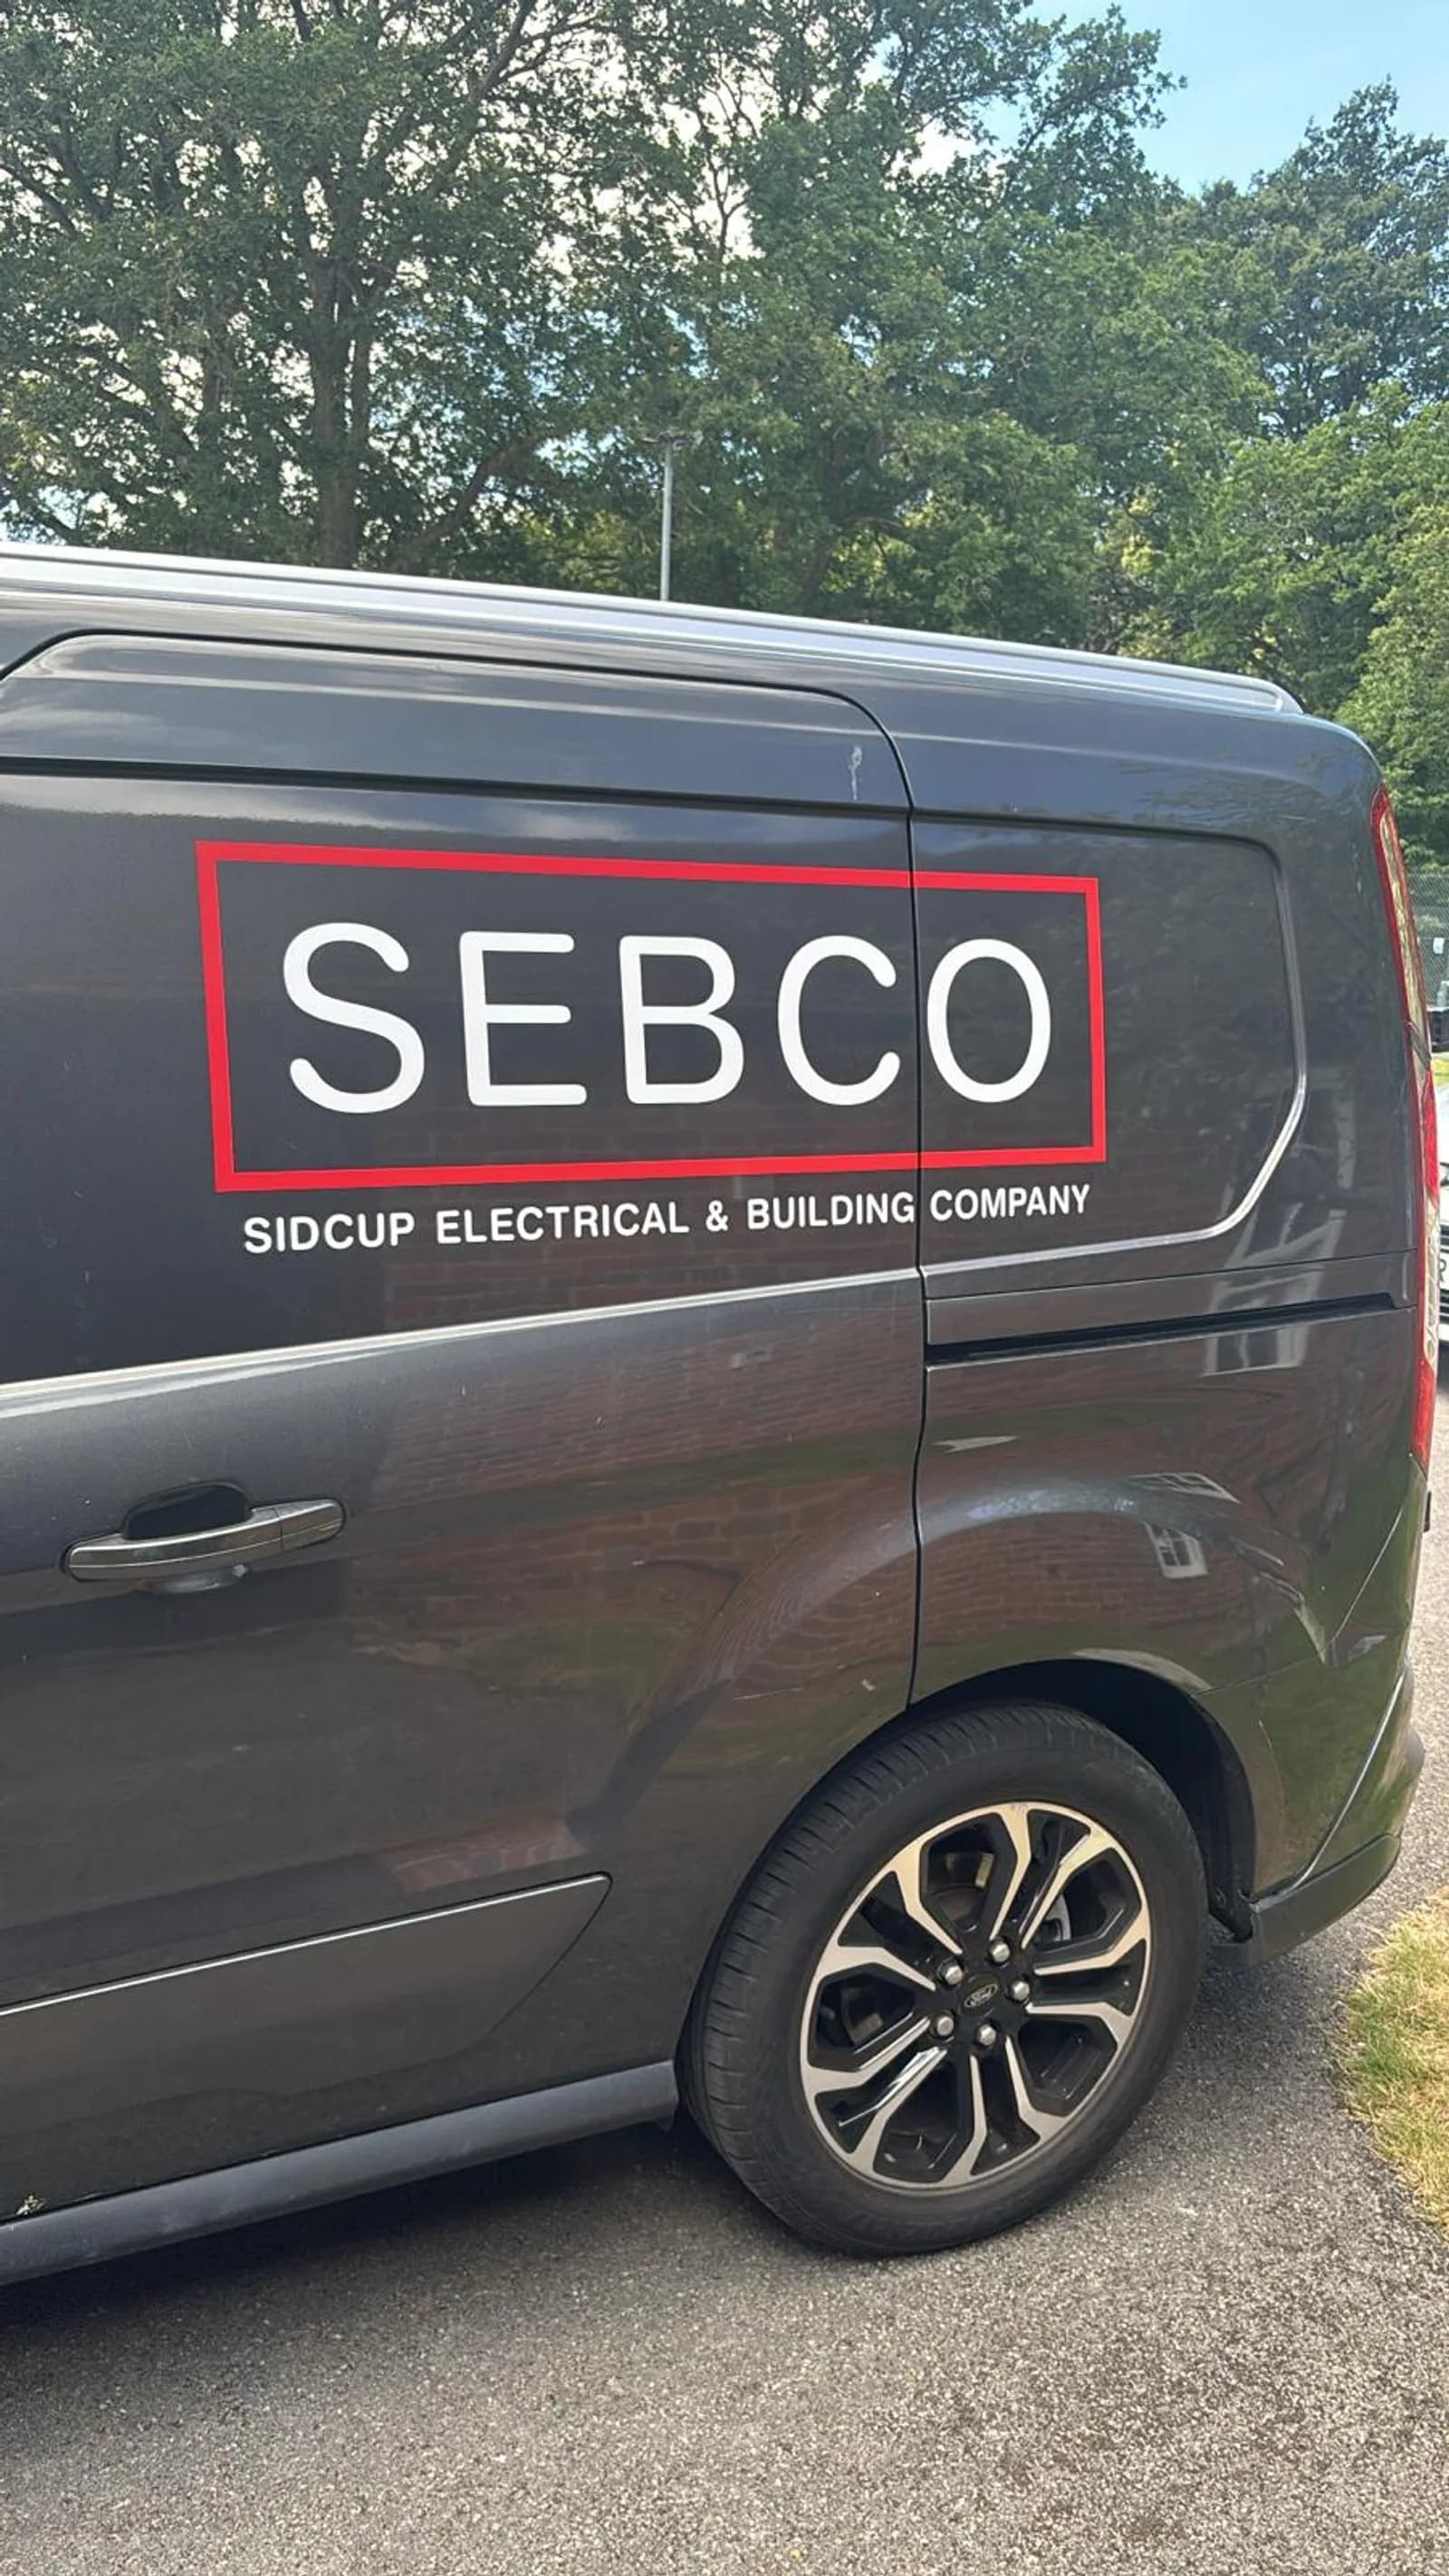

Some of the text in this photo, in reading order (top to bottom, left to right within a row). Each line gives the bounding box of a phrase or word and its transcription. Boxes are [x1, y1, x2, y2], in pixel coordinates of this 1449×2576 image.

[282, 921, 1052, 1114] SEBCO
[243, 1183, 1092, 1254] SIDCUP ELECTRICAL & BUILDING COMPANY
